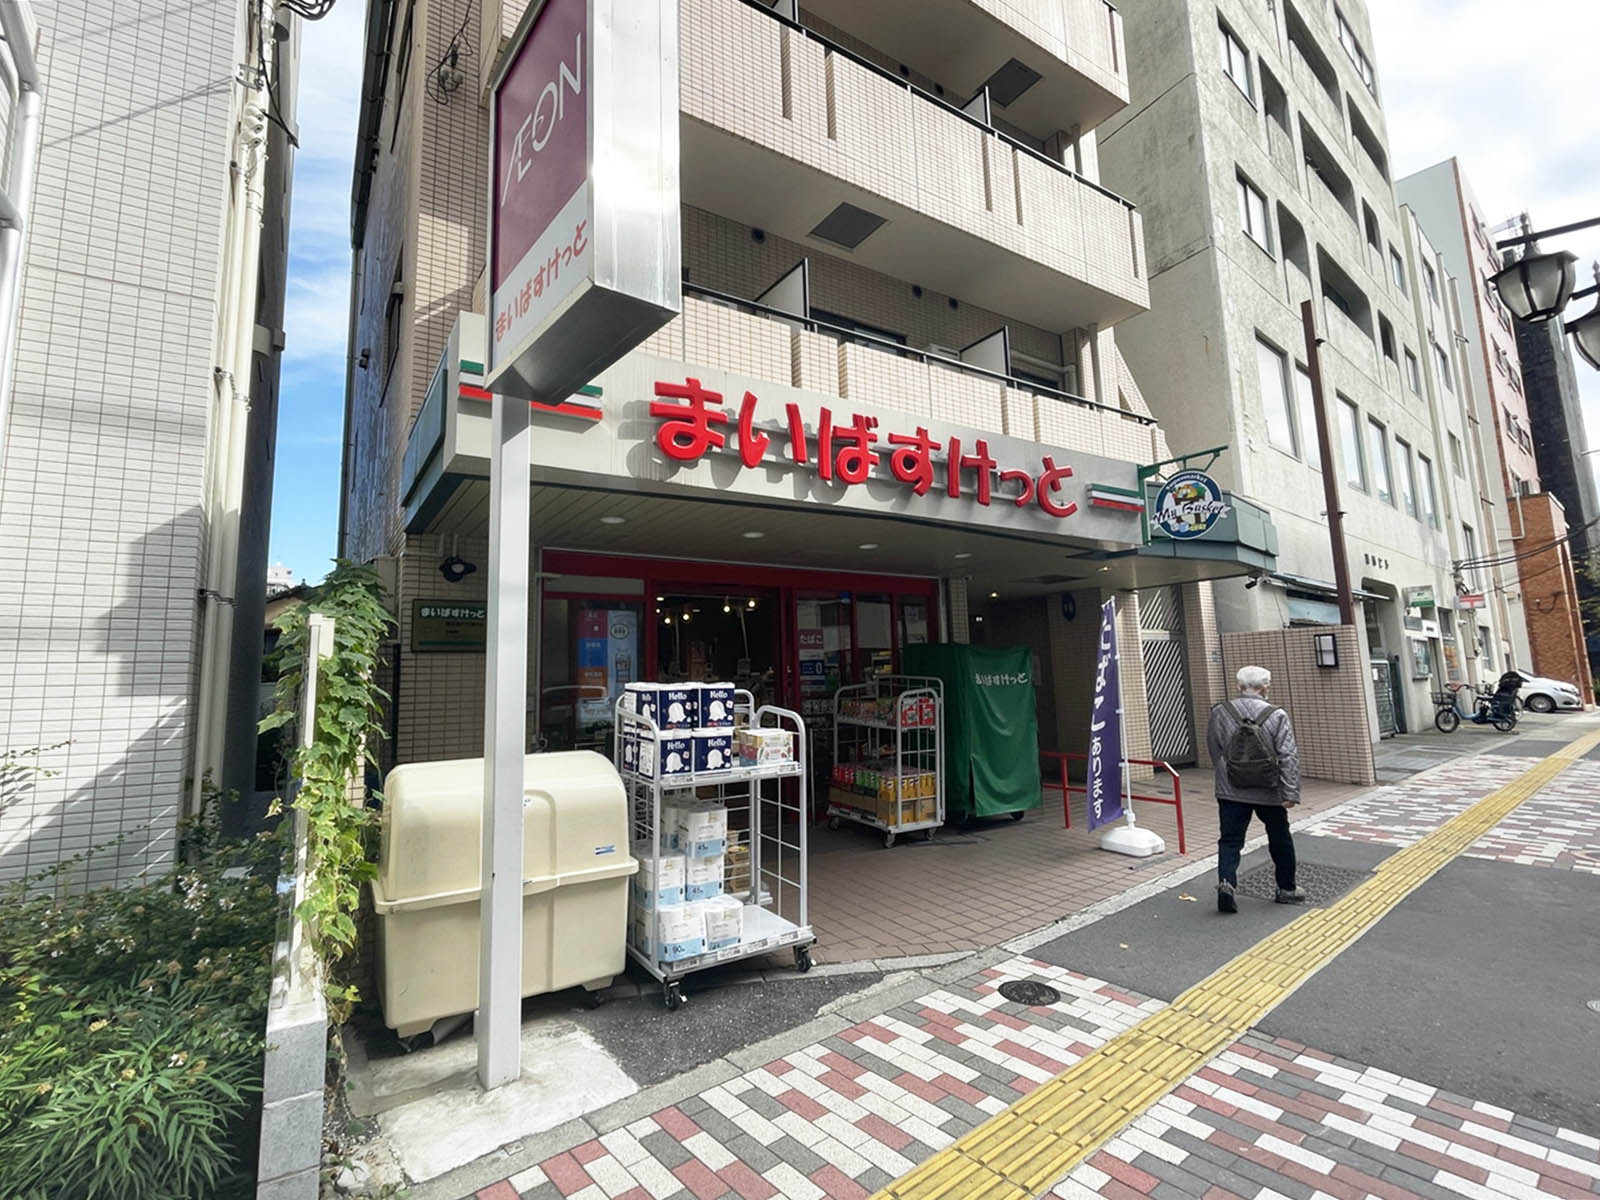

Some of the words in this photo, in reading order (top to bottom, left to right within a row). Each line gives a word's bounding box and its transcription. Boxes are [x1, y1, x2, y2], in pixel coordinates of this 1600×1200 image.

[495, 220, 589, 341] まいばすけっと
[649, 377, 1078, 517] まいばすけっと
[1151, 508, 1177, 522] My
[1183, 500, 1224, 515] Basket
[421, 607, 485, 618] まいばすけっと
[800, 632, 824, 645] たばこ
[668, 691, 688, 701] Hello
[709, 689, 729, 699] Hello
[666, 741, 686, 751] Hello
[707, 738, 727, 748] Hello
